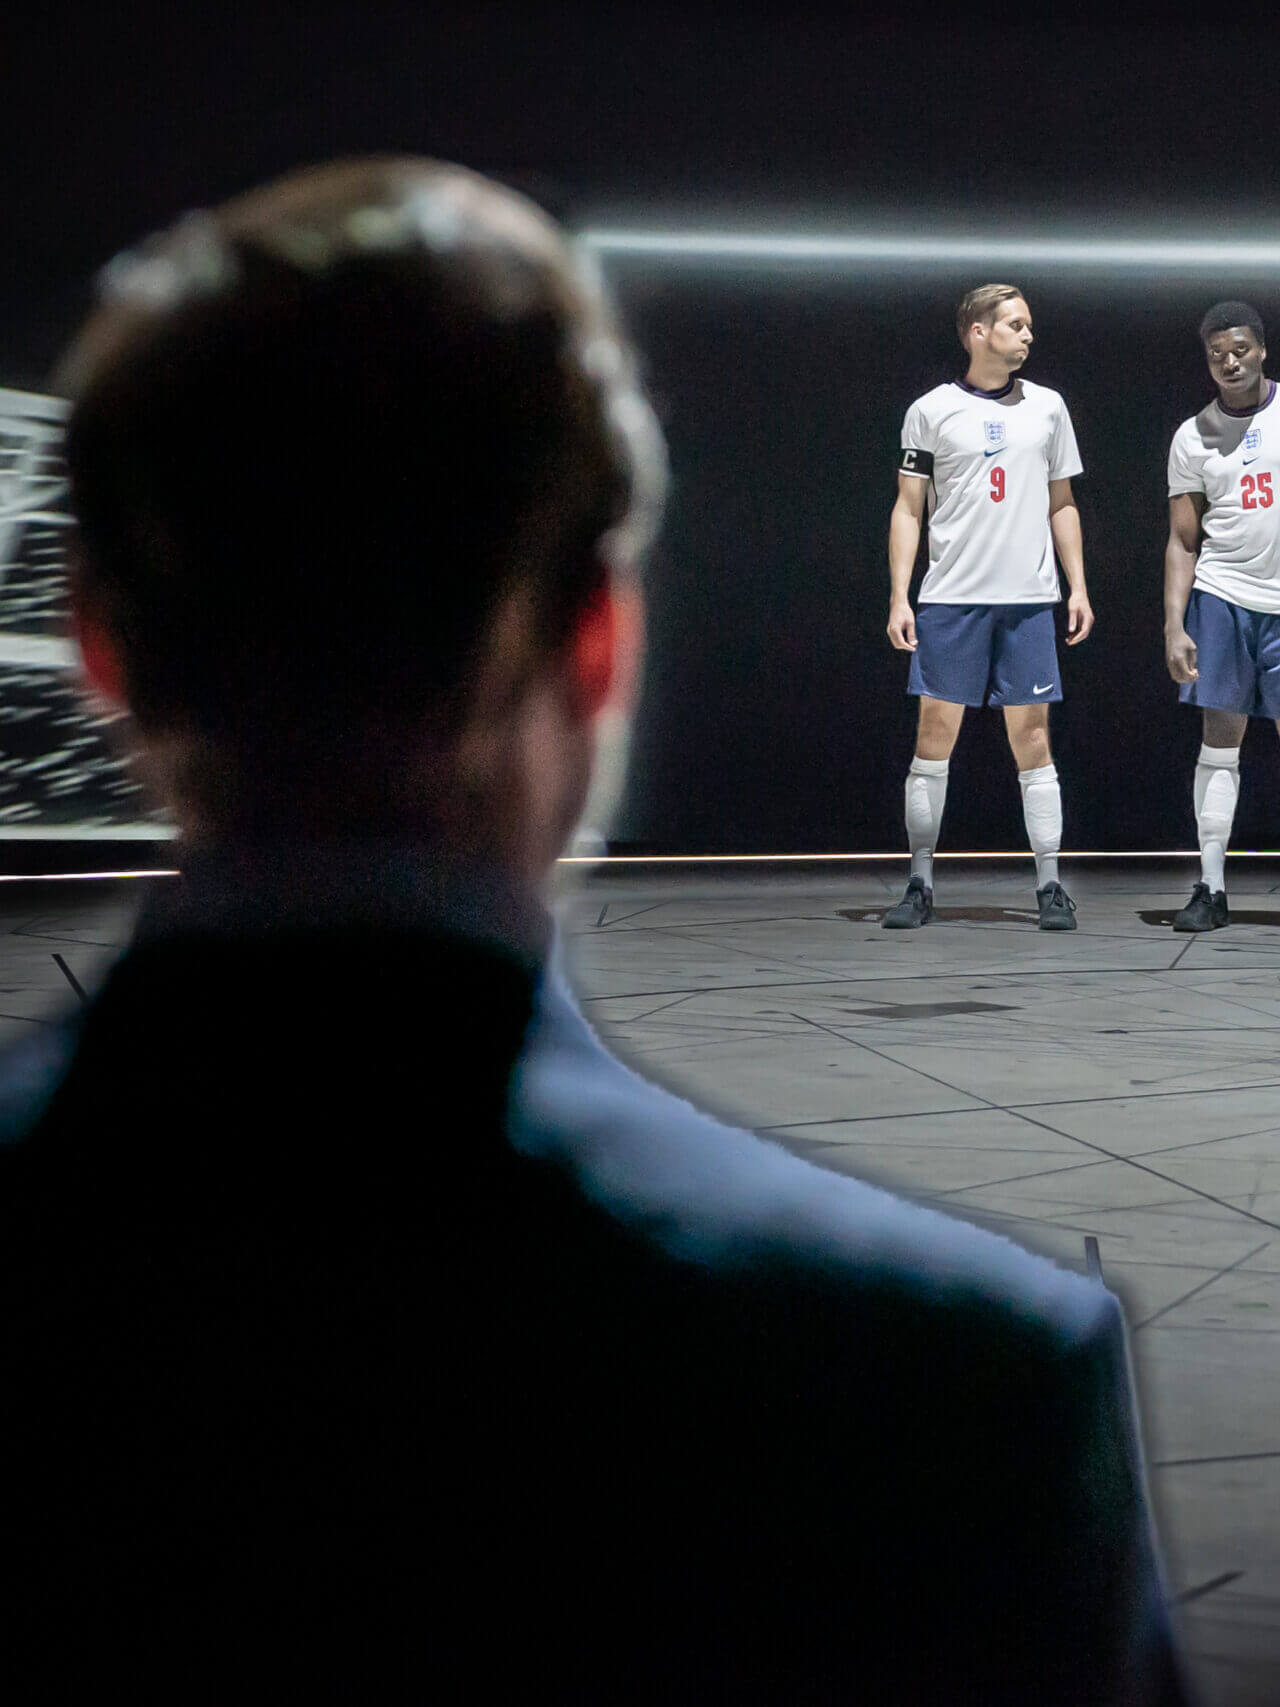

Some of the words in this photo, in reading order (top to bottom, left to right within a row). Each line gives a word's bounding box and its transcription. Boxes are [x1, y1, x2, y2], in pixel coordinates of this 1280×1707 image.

[904, 450, 917, 469] C
[990, 466, 1005, 503] 9
[1240, 472, 1274, 510] 25
